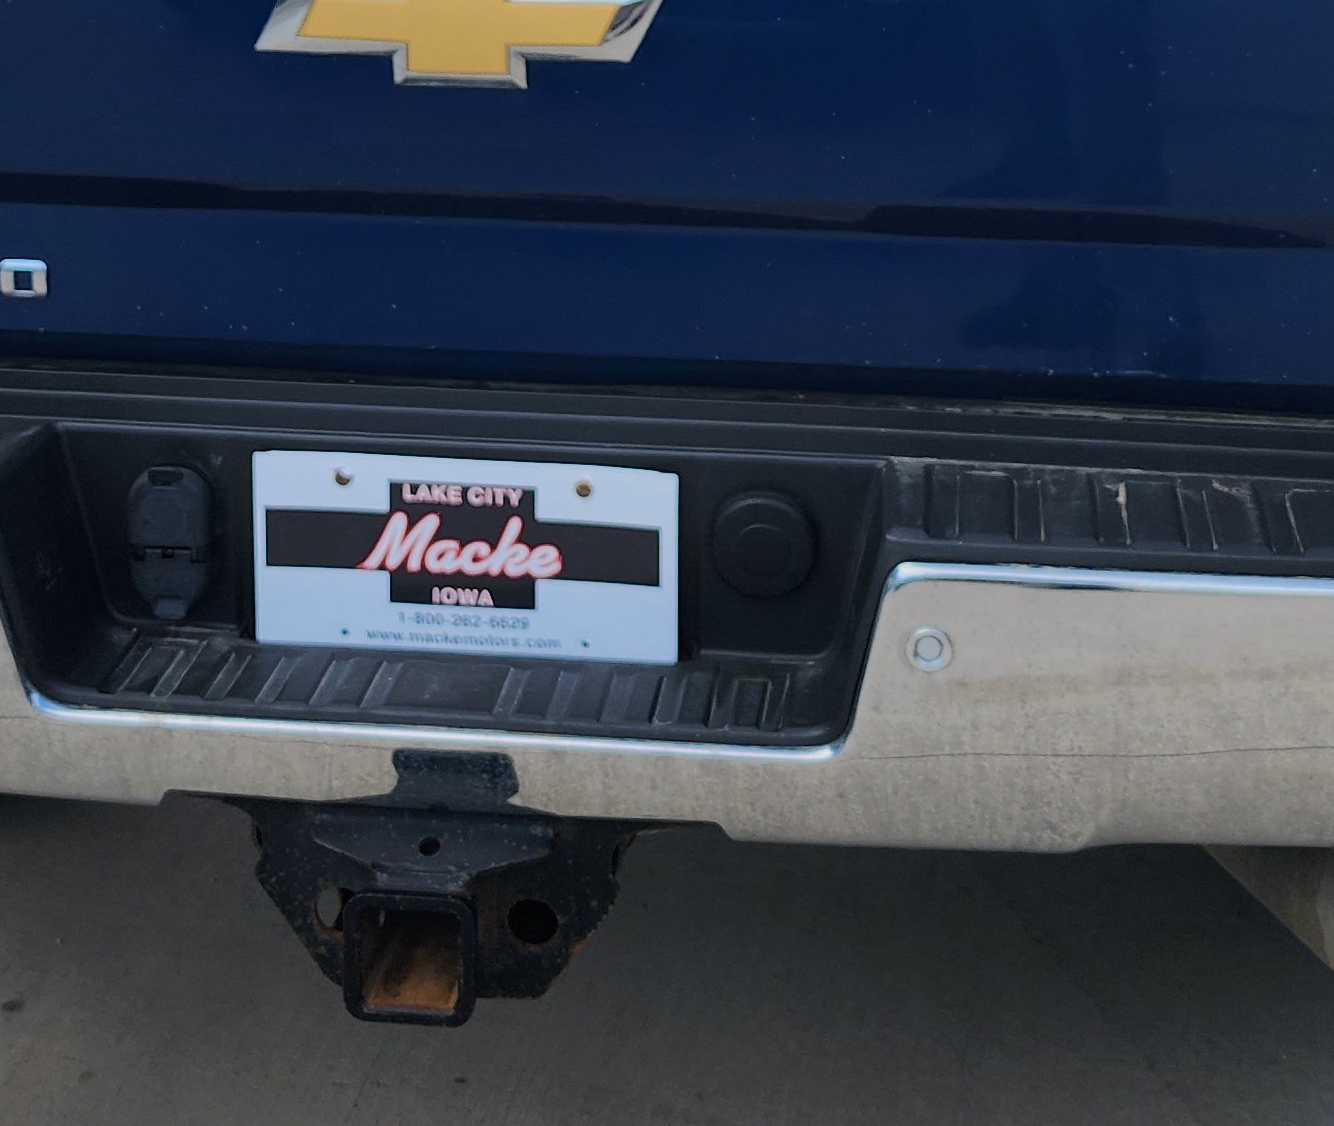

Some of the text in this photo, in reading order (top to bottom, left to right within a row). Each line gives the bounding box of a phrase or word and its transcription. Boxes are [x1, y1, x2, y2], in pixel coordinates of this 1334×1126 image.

[402, 482, 524, 508] LAKE CITY
[356, 510, 563, 580] Macke
[431, 586, 495, 608] IOWA
[364, 628, 562, 650] www.mackemotors.com
